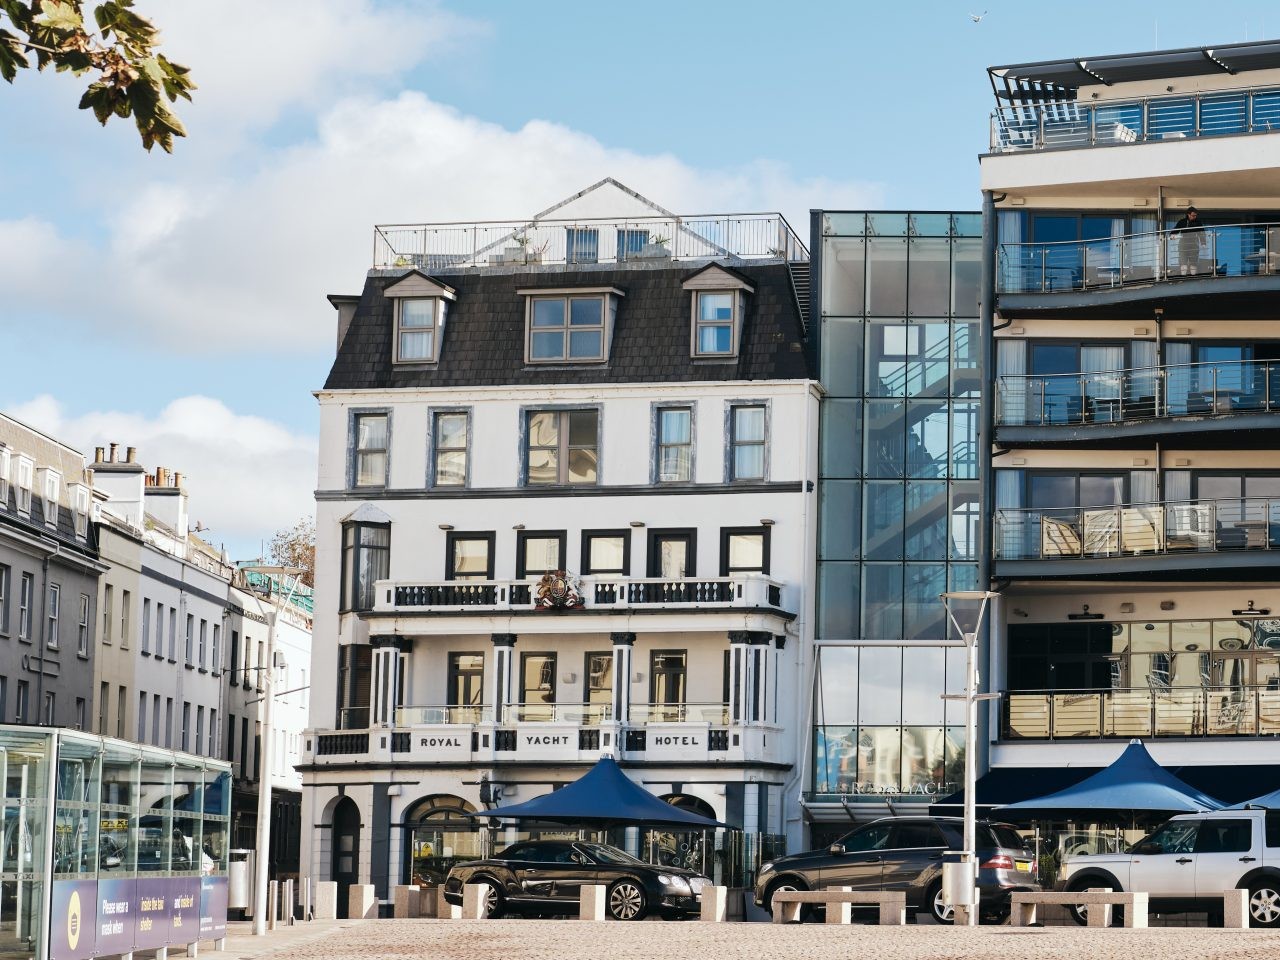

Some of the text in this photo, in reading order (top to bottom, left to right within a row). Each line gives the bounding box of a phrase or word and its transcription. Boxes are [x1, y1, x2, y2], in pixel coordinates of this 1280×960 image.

[420, 738, 461, 747] ROYAL
[526, 736, 569, 745] YACHT
[655, 736, 699, 745] HOTEL
[102, 899, 115, 914] Please
[115, 901, 125, 913] wear
[101, 920, 124, 936] mask when
